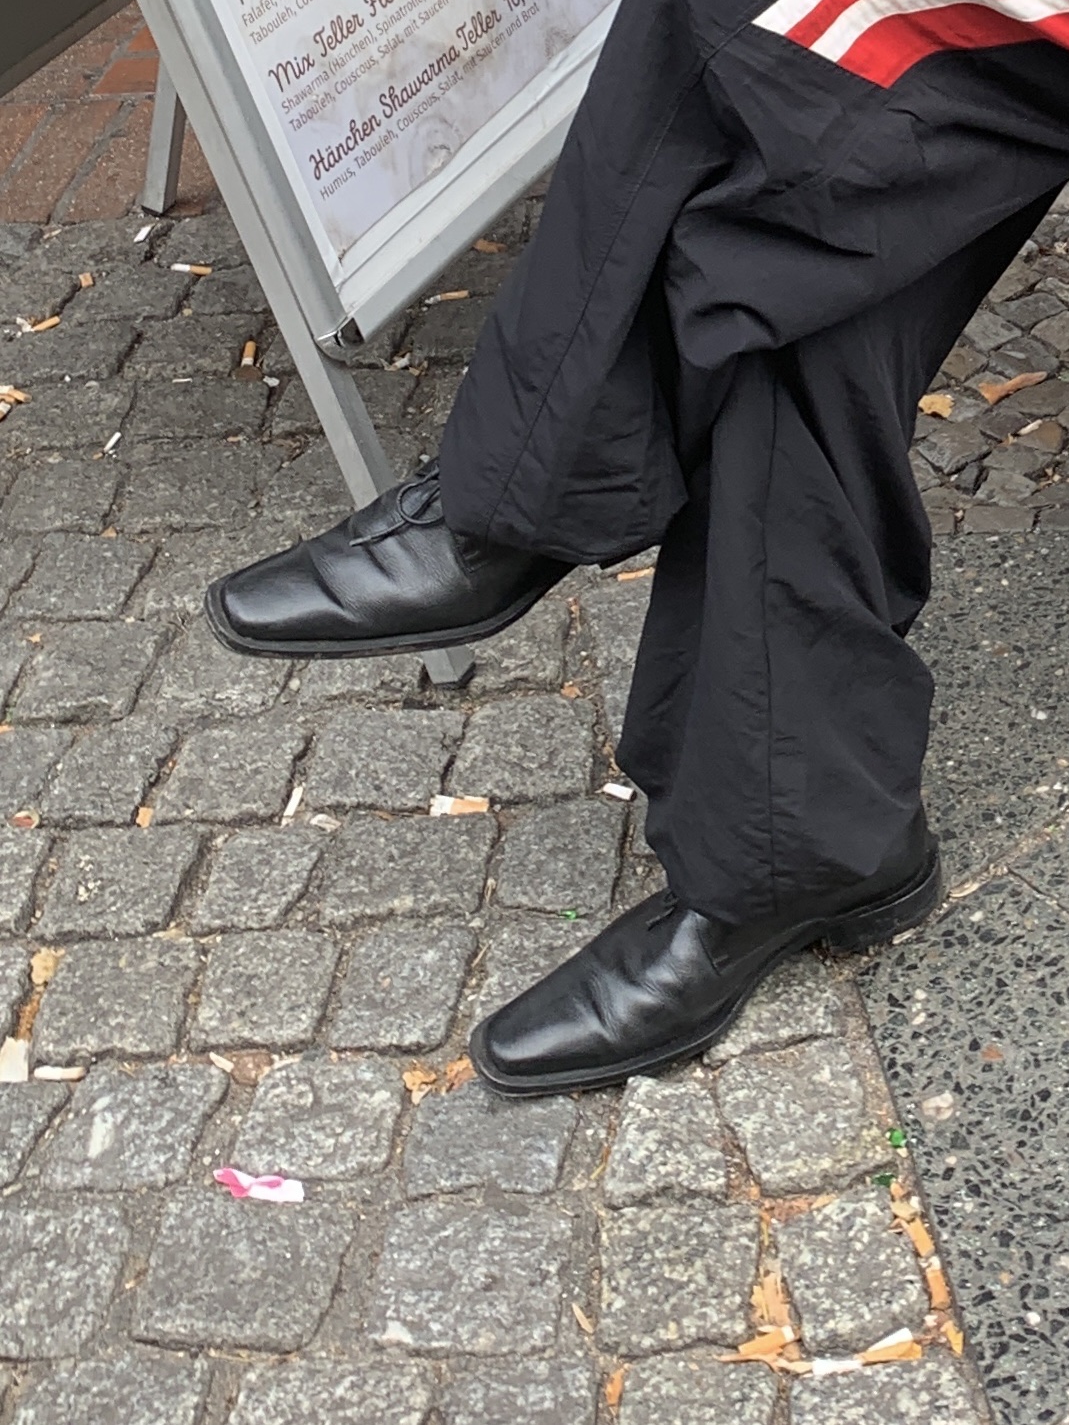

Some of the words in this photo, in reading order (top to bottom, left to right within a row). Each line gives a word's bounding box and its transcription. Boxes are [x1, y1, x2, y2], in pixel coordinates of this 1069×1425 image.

[248, 5, 298, 45] Tabouleh,
[267, 53, 316, 93] Mix
[312, 13, 365, 58] Teller
[280, 70, 331, 115] Shawarma
[327, 28, 378, 76] (Hänchen),
[288, 91, 337, 132] Tabouleh,
[333, 55, 380, 95] Couscous,
[377, 33, 405, 59] Salat,
[403, 19, 420, 38] mit
[308, 114, 382, 181] Hänchen
[378, 45, 461, 119] Shawarma
[455, 9, 502, 51] Teller
[319, 167, 357, 201] Humus,
[353, 128, 399, 170] Tabouleh,
[396, 92, 441, 132] Couscous,
[437, 70, 465, 96] Salat,
[505, 14, 523, 37] und
[520, 1, 540, 23] Brot
